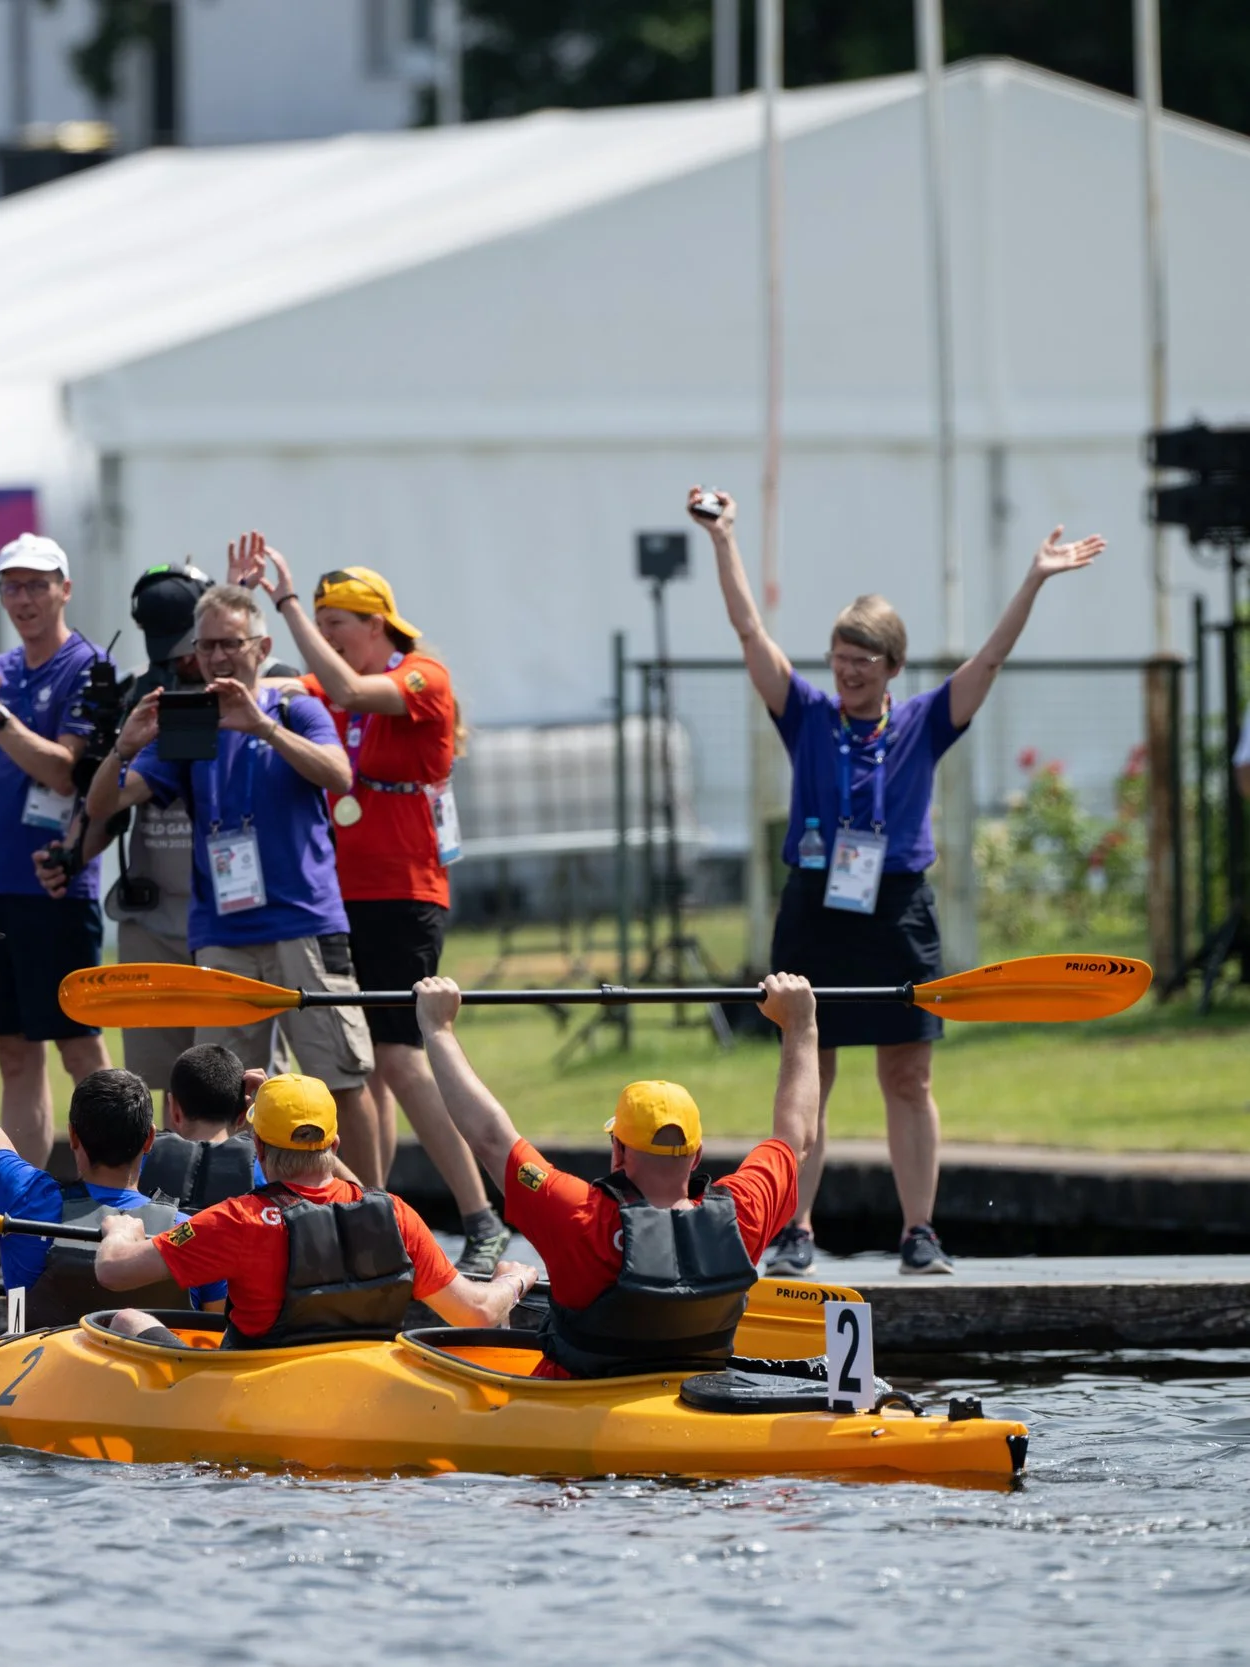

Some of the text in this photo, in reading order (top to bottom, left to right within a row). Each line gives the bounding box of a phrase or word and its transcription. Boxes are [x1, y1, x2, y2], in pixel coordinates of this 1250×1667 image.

[1065, 962, 1107, 973] PRIJON
[261, 1206, 282, 1226] G
[776, 1288, 818, 1301] PRIJON
[837, 1308, 861, 1393] 2
